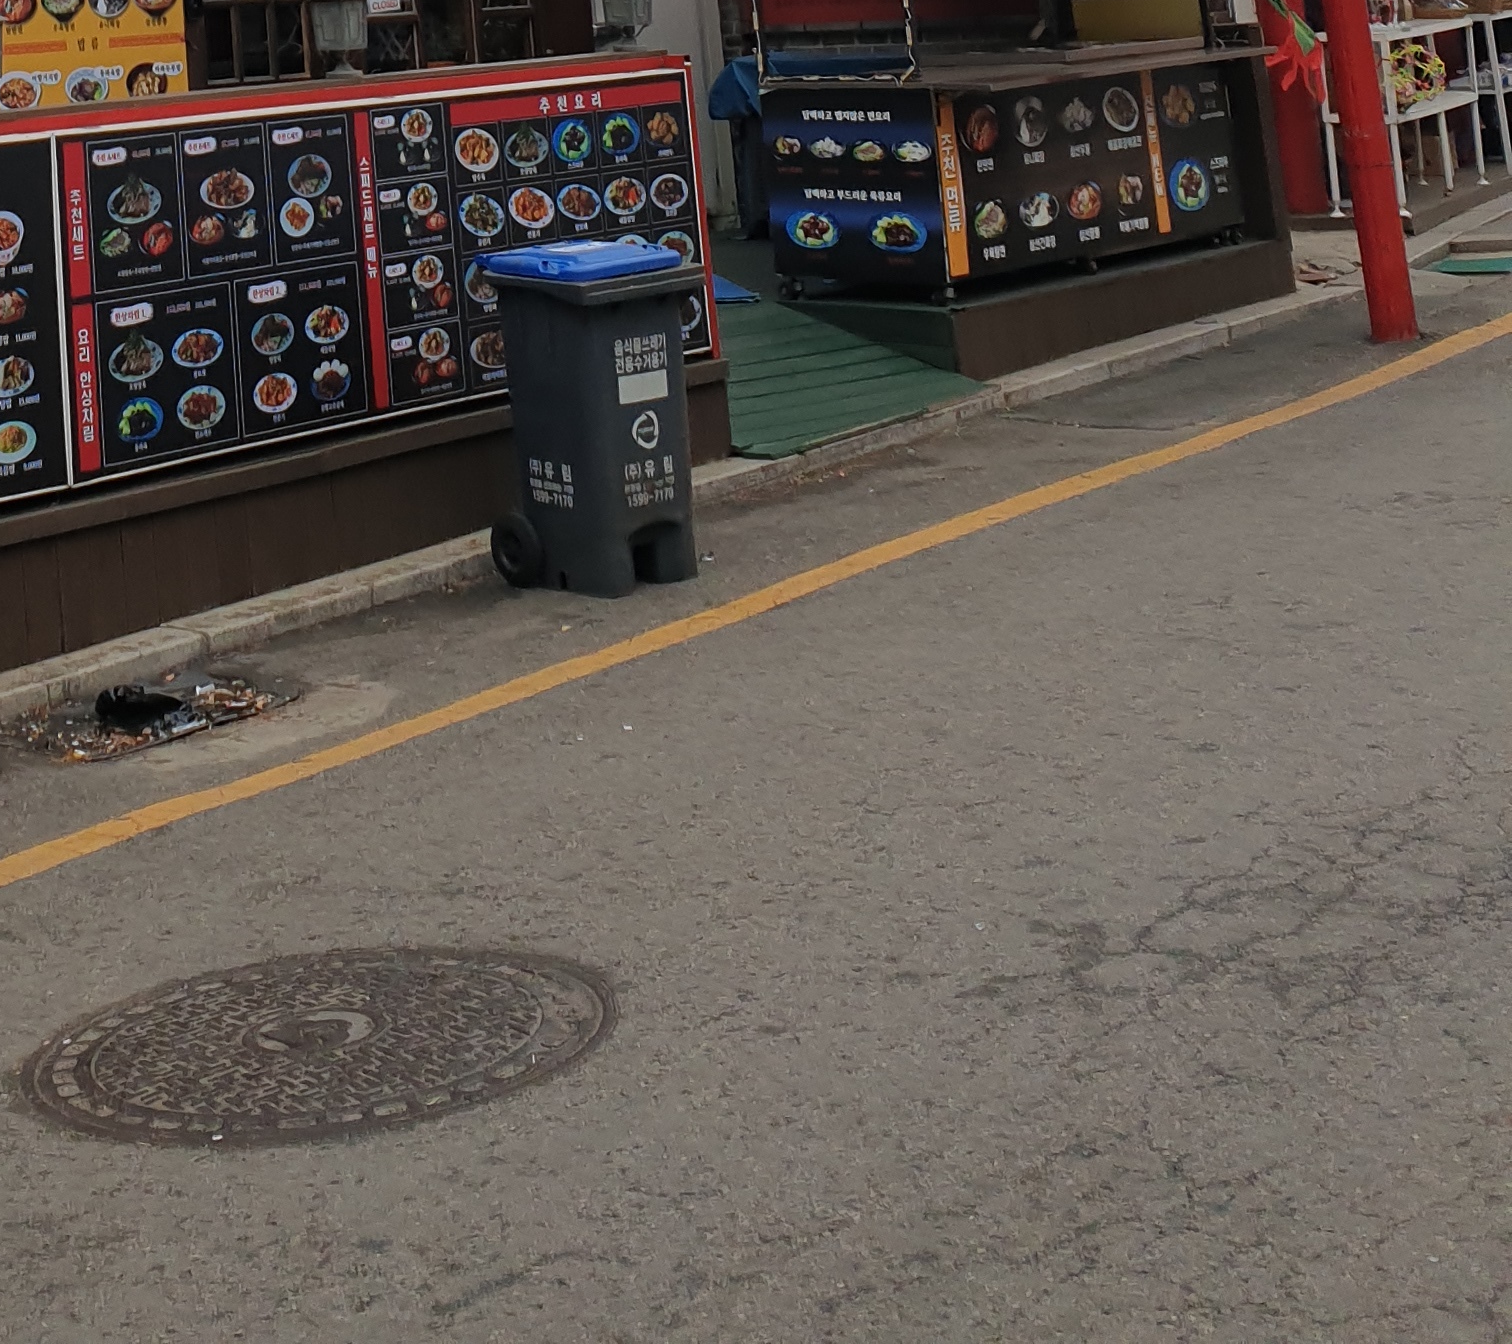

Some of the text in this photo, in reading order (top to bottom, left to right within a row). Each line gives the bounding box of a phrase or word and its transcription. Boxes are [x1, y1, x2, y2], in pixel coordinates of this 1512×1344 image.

[372, 0, 399, 11] CLOSED
[614, 332, 668, 357] 음식물쓰레기
[615, 351, 669, 374] 전용수거용기
